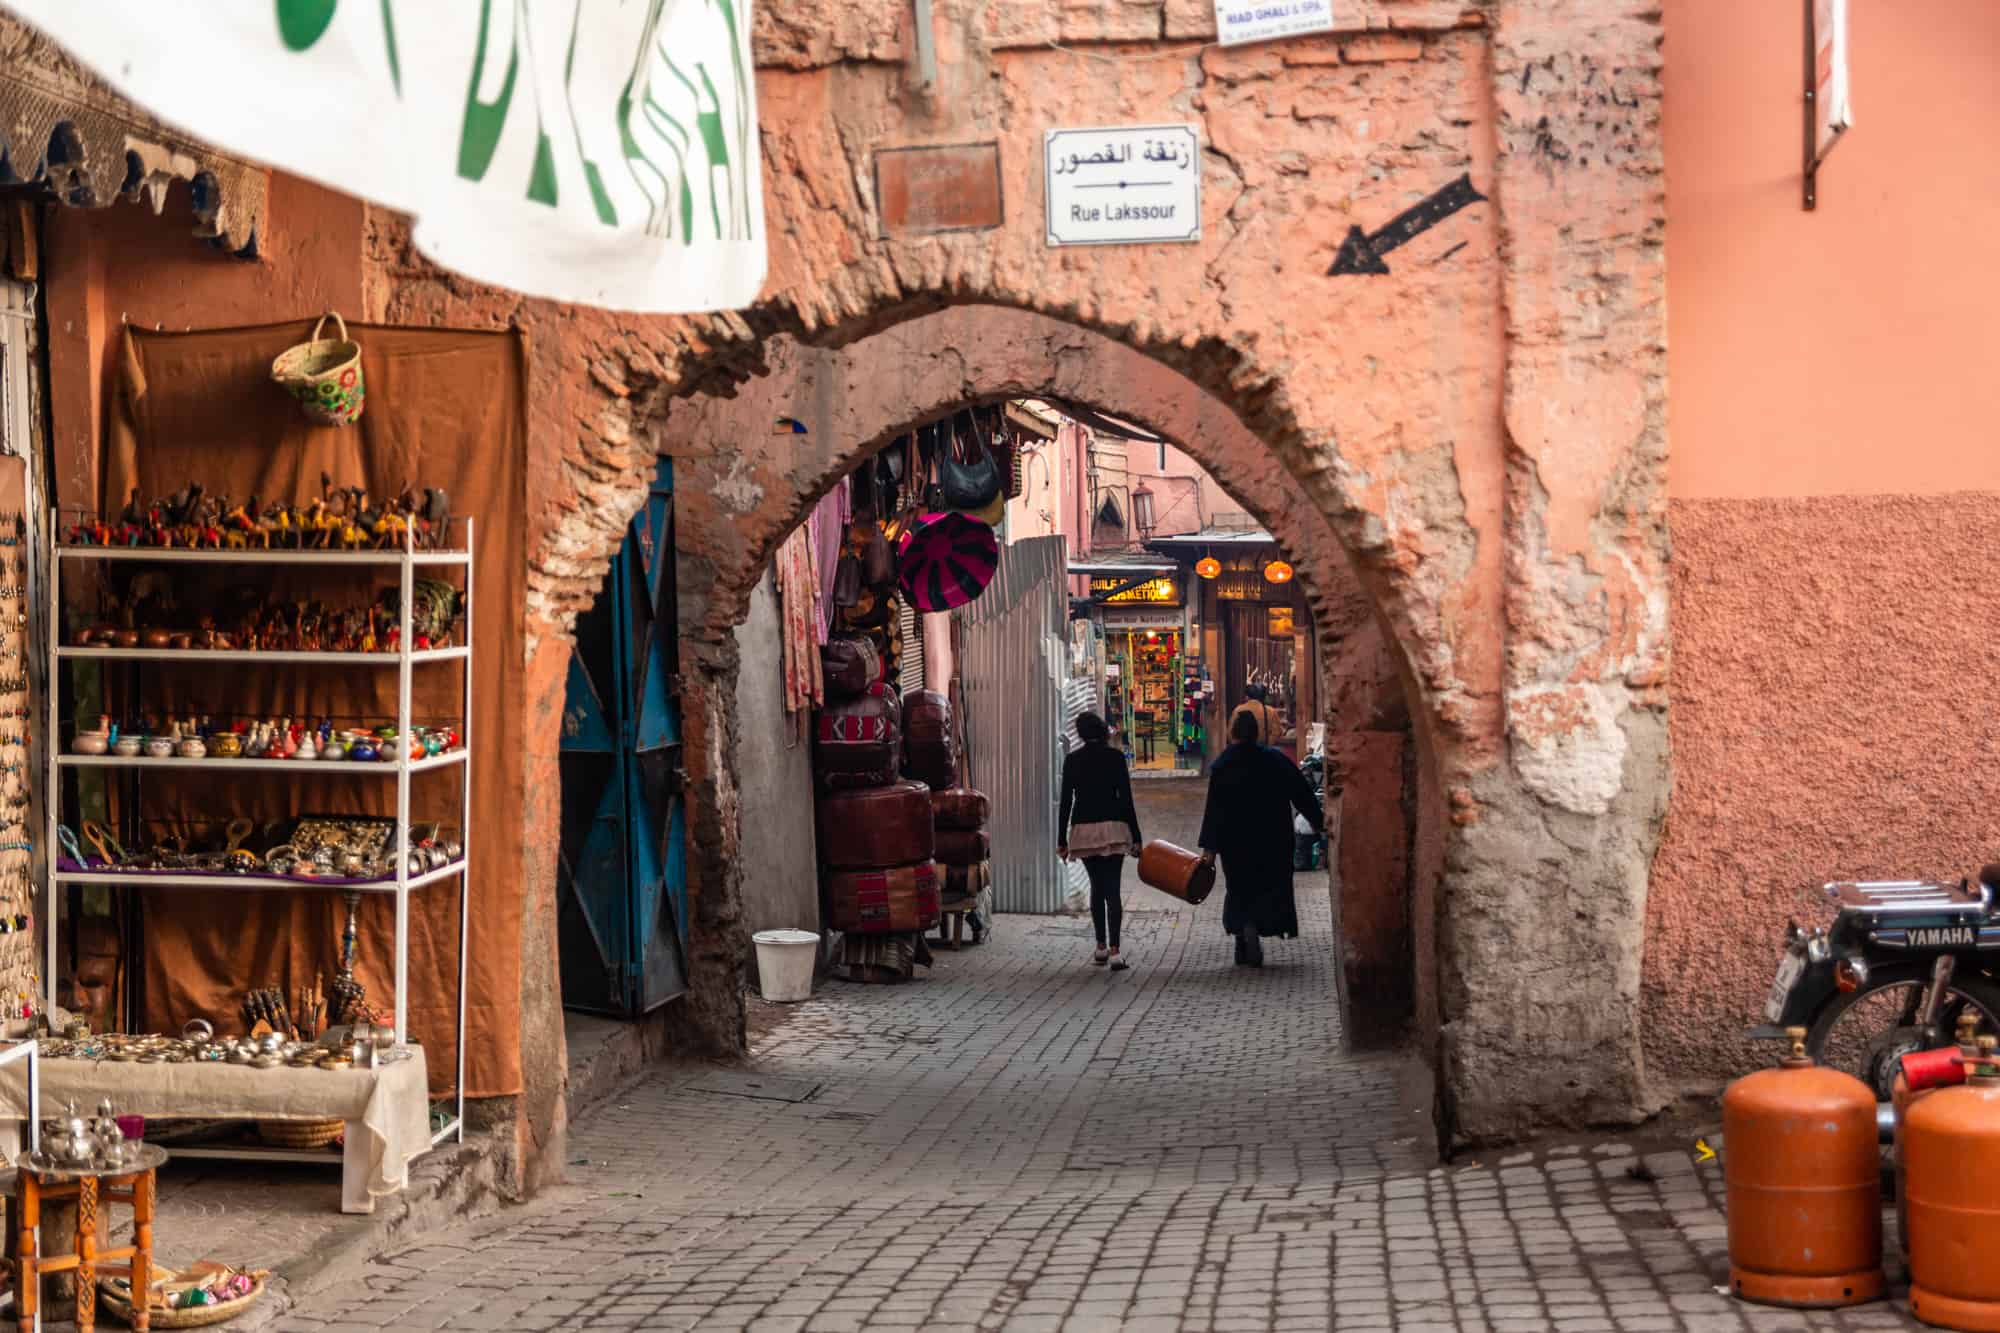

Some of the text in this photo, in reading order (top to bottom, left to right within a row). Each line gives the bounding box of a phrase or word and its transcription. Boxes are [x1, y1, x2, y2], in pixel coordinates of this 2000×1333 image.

[1226, 11, 1253, 24] RIAD
[1255, 6, 1289, 20] GHALI
[1055, 139, 1190, 175] زنقة القصور
[1070, 202, 1176, 222] Rue Lakssour
[1907, 927, 1974, 945] YAMAHA
